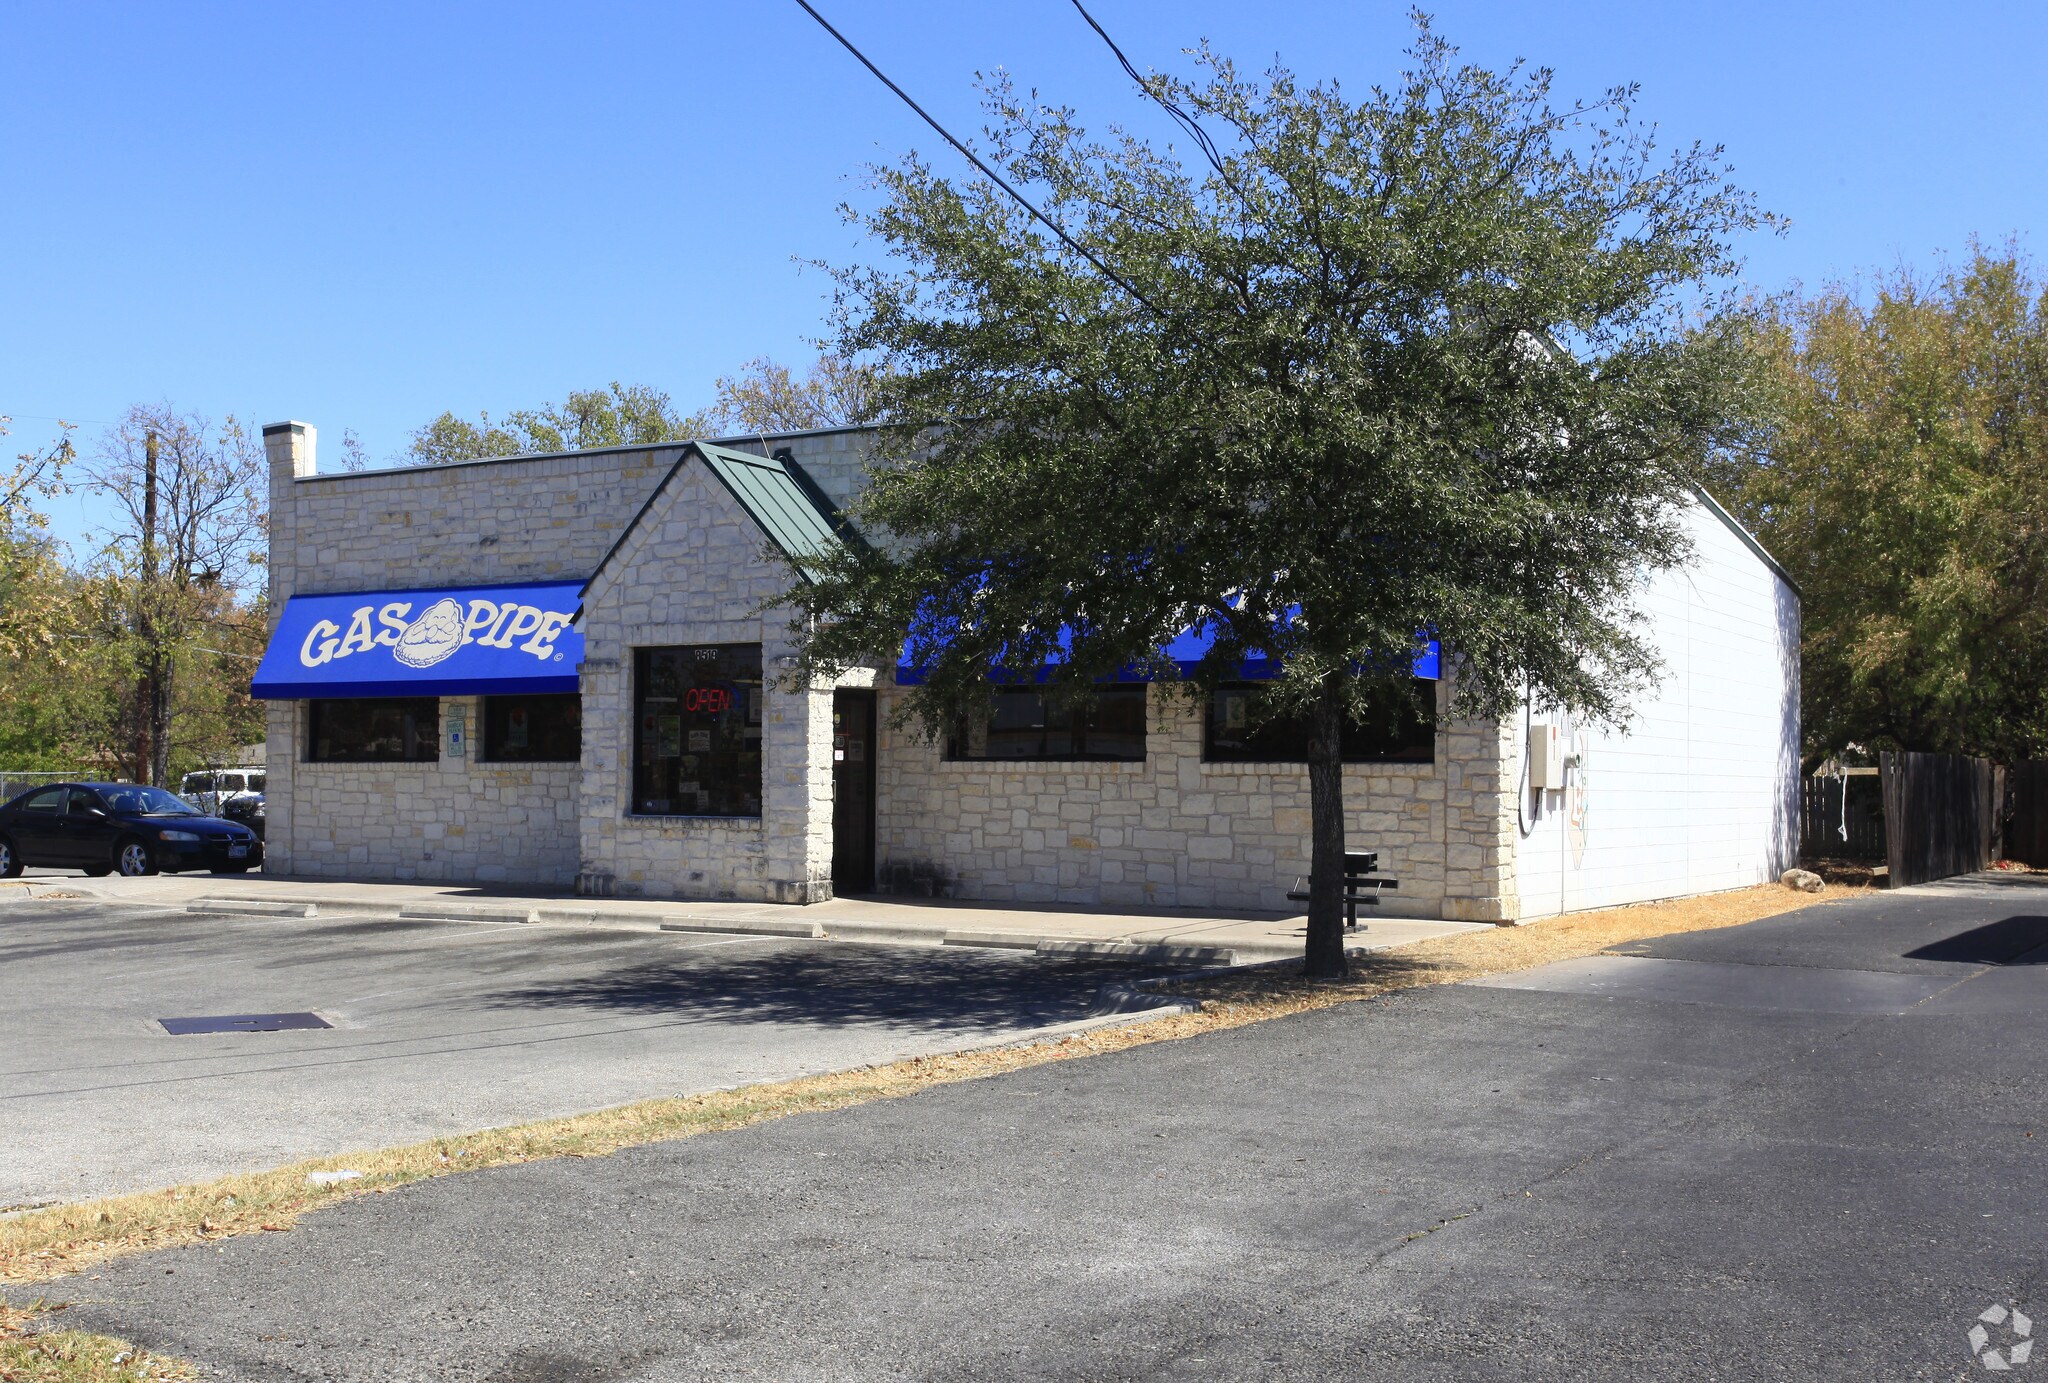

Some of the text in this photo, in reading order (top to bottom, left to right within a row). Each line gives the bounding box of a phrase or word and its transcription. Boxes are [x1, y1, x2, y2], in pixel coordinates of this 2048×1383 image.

[300, 602, 412, 667] GAS
[461, 599, 574, 660] PIPE
[687, 687, 731, 713] OPEN
